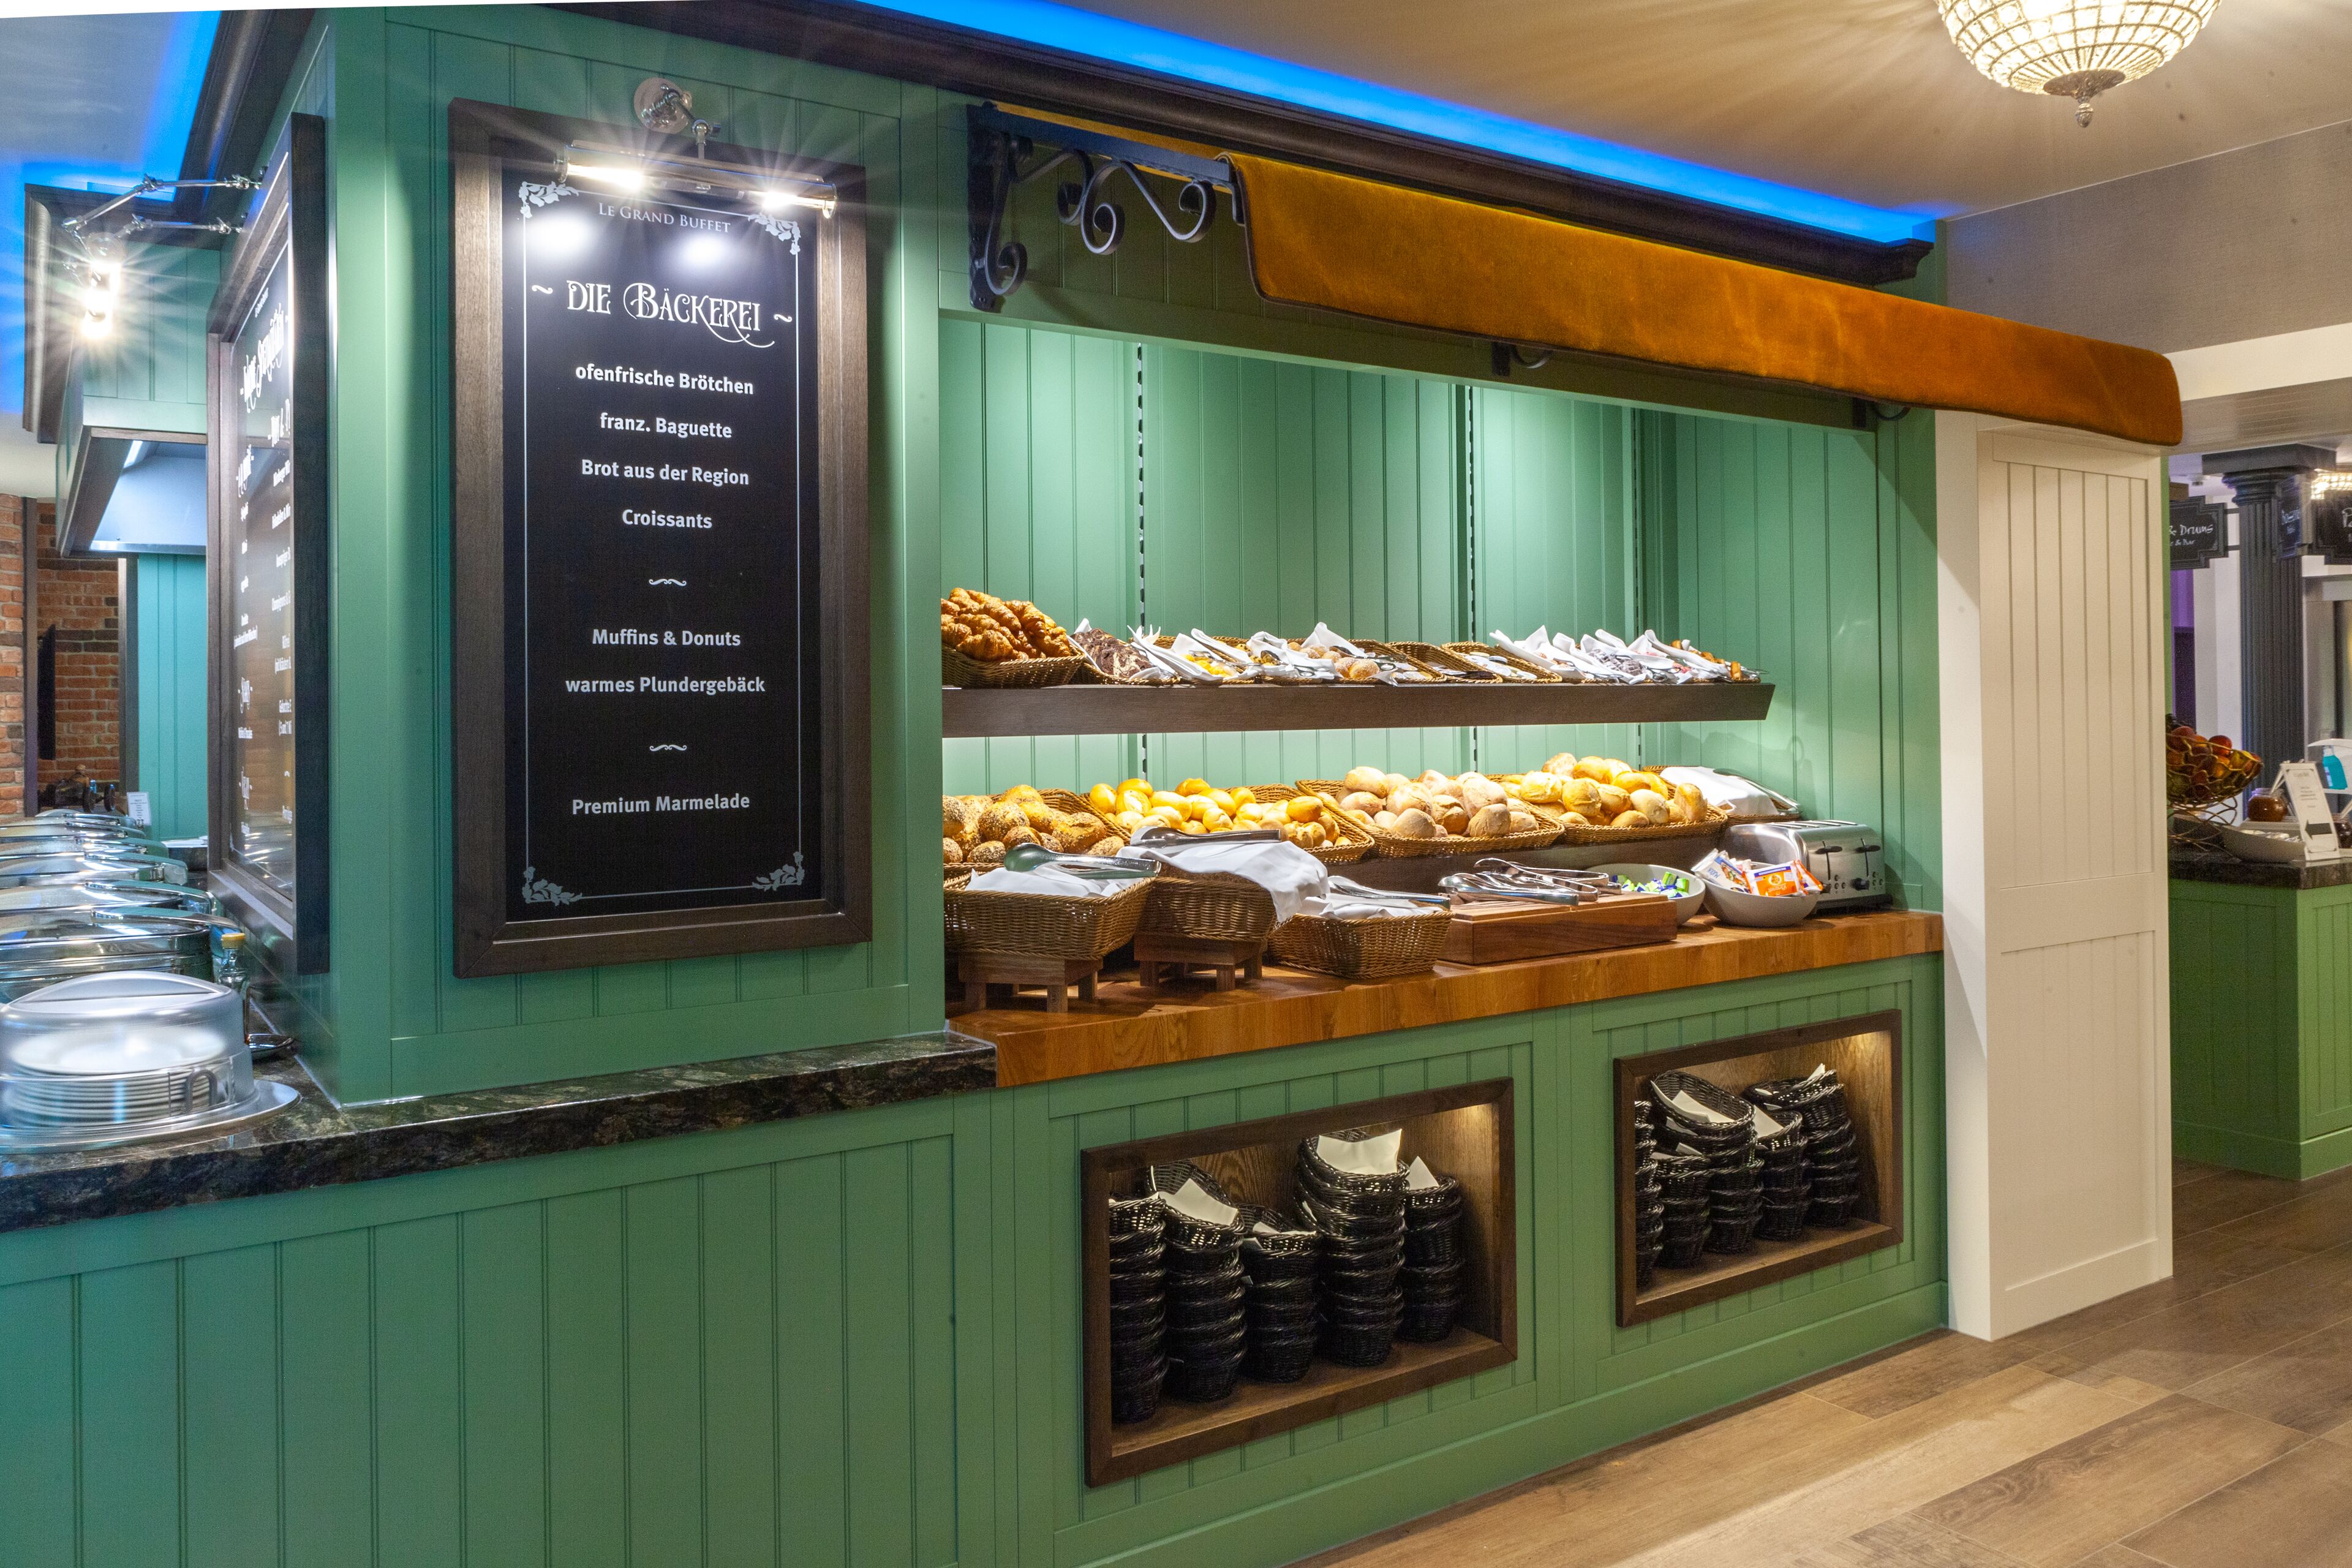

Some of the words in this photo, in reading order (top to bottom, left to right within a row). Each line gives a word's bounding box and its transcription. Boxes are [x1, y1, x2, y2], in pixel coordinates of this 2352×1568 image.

[620, 206, 674, 225] GRAND
[680, 215, 731, 233] BUFFET
[567, 281, 611, 314] DIE
[624, 283, 775, 348] BÄCKEREI
[576, 363, 674, 387] ofenfrische
[679, 373, 753, 394] Brötchen
[600, 412, 650, 432] franz.
[656, 417, 732, 438] Baguette
[582, 459, 619, 477] Brot
[624, 466, 655, 479] aus
[659, 464, 688, 481] der
[692, 467, 748, 487] Region
[622, 509, 712, 529] Croissants
[2179, 524, 2214, 536] Drums
[592, 628, 658, 645] Muffins
[663, 631, 677, 645] &
[682, 630, 741, 646] Donuts
[565, 680, 635, 692] warmes
[640, 676, 766, 695] Plundergebäck
[573, 797, 649, 815] Premium
[656, 793, 750, 811] Marmelade
